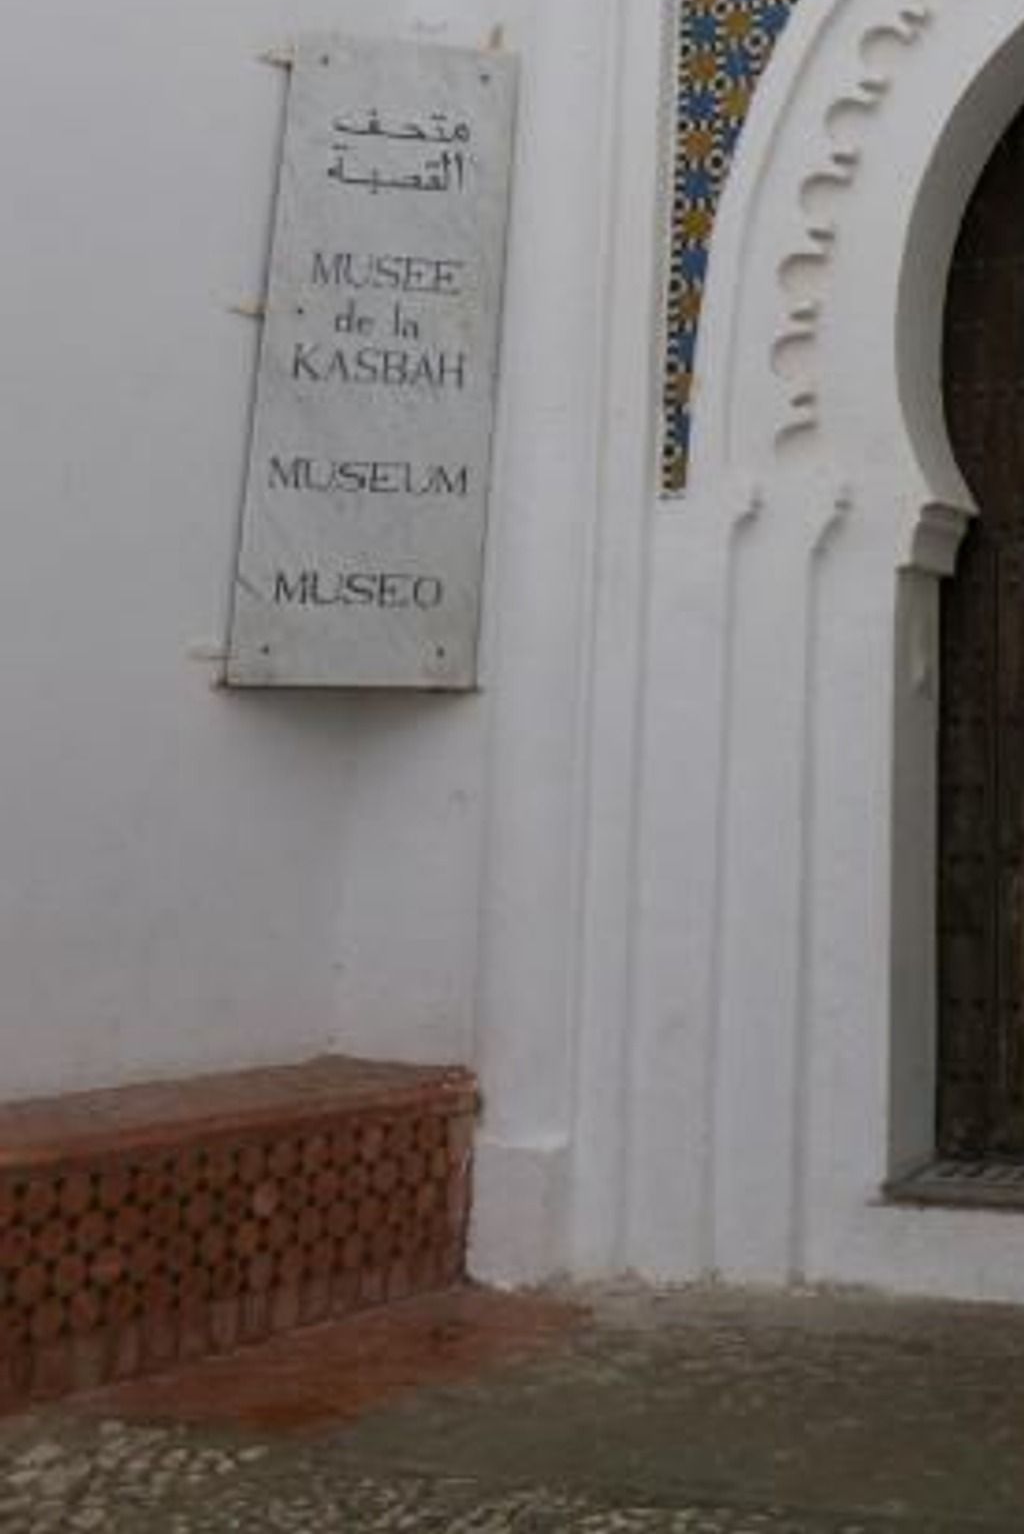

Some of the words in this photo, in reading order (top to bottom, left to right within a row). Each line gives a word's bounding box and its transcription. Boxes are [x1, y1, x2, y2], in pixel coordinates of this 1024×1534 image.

[311, 252, 464, 296] MUSEE
[334, 298, 375, 336] de
[393, 302, 420, 340] la
[292, 342, 464, 390] KASBAH
[268, 457, 467, 496] MUSEUM
[274, 569, 442, 610] MUSEO
